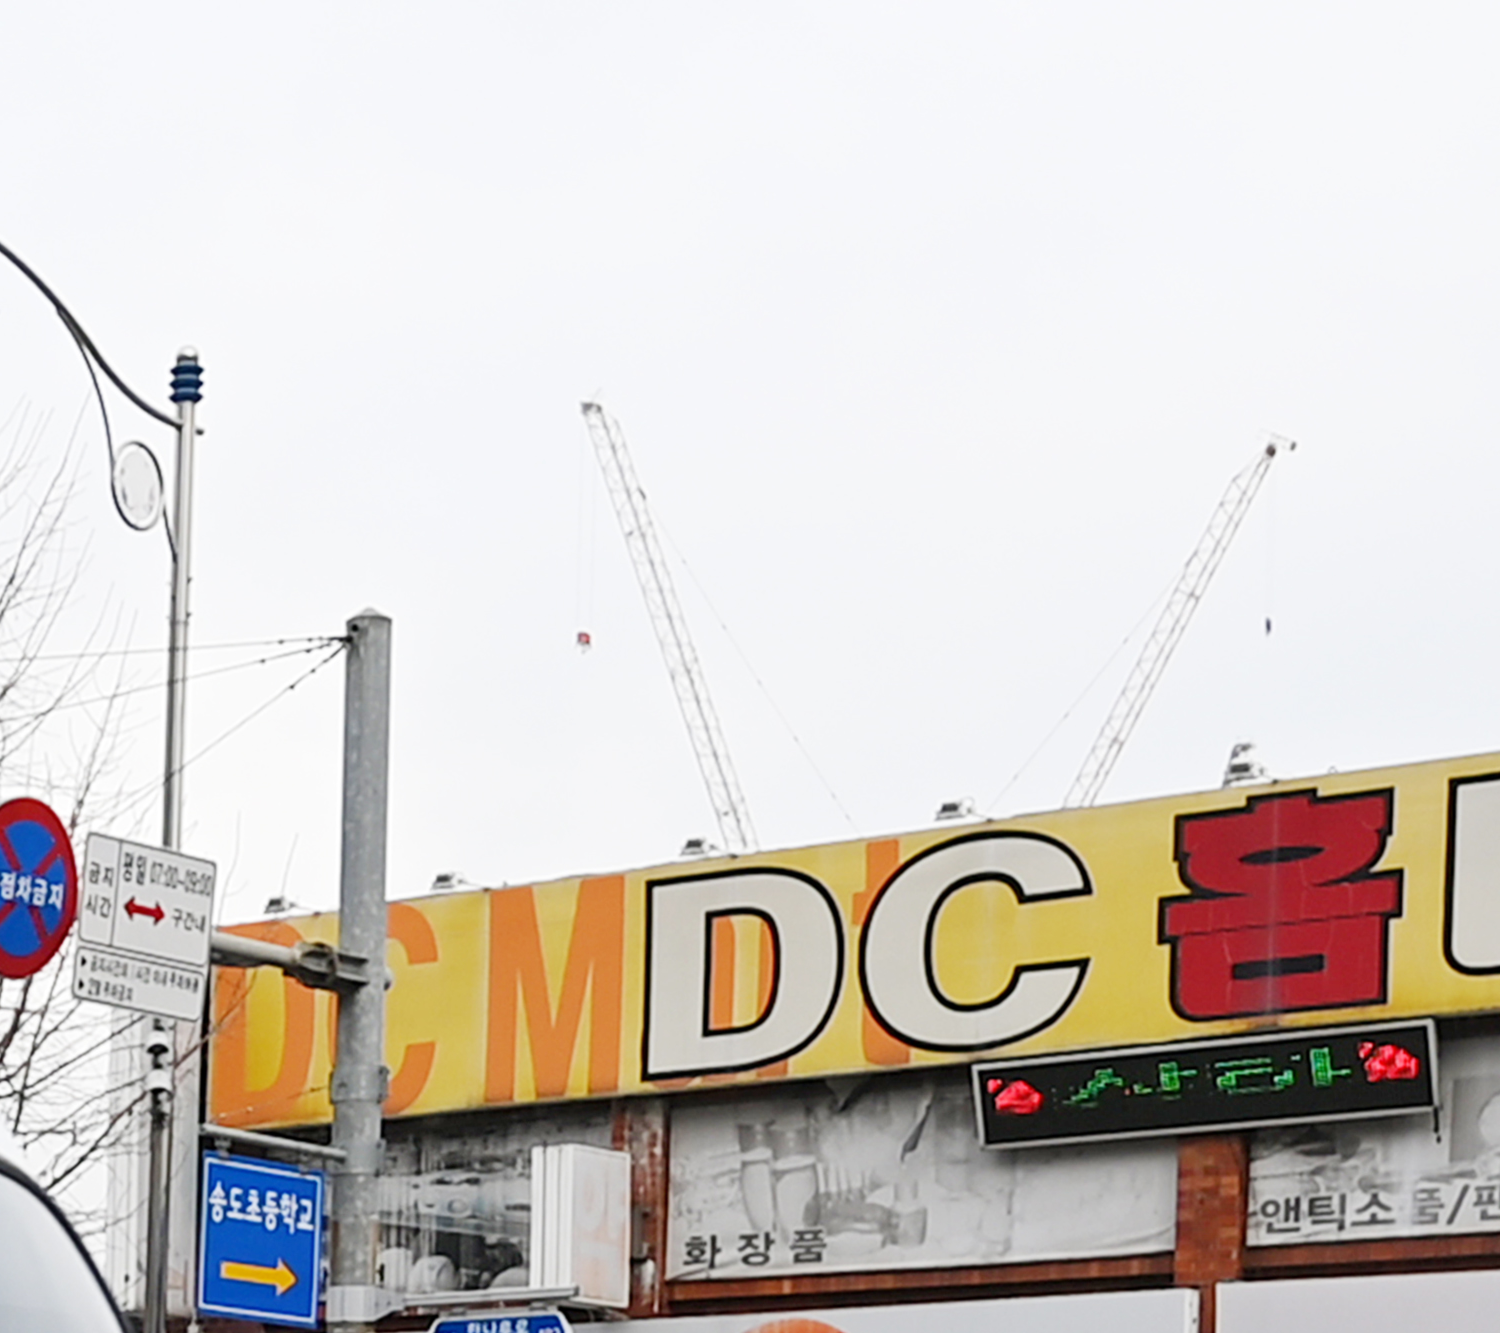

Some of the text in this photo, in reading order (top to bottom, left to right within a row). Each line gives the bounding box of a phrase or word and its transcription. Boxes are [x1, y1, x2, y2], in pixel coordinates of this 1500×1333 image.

[89, 862, 114, 887] 금지
[86, 894, 111, 919] 시간
[209, 1180, 314, 1235] 송도초등학교
[682, 1228, 828, 1269] 화장품
